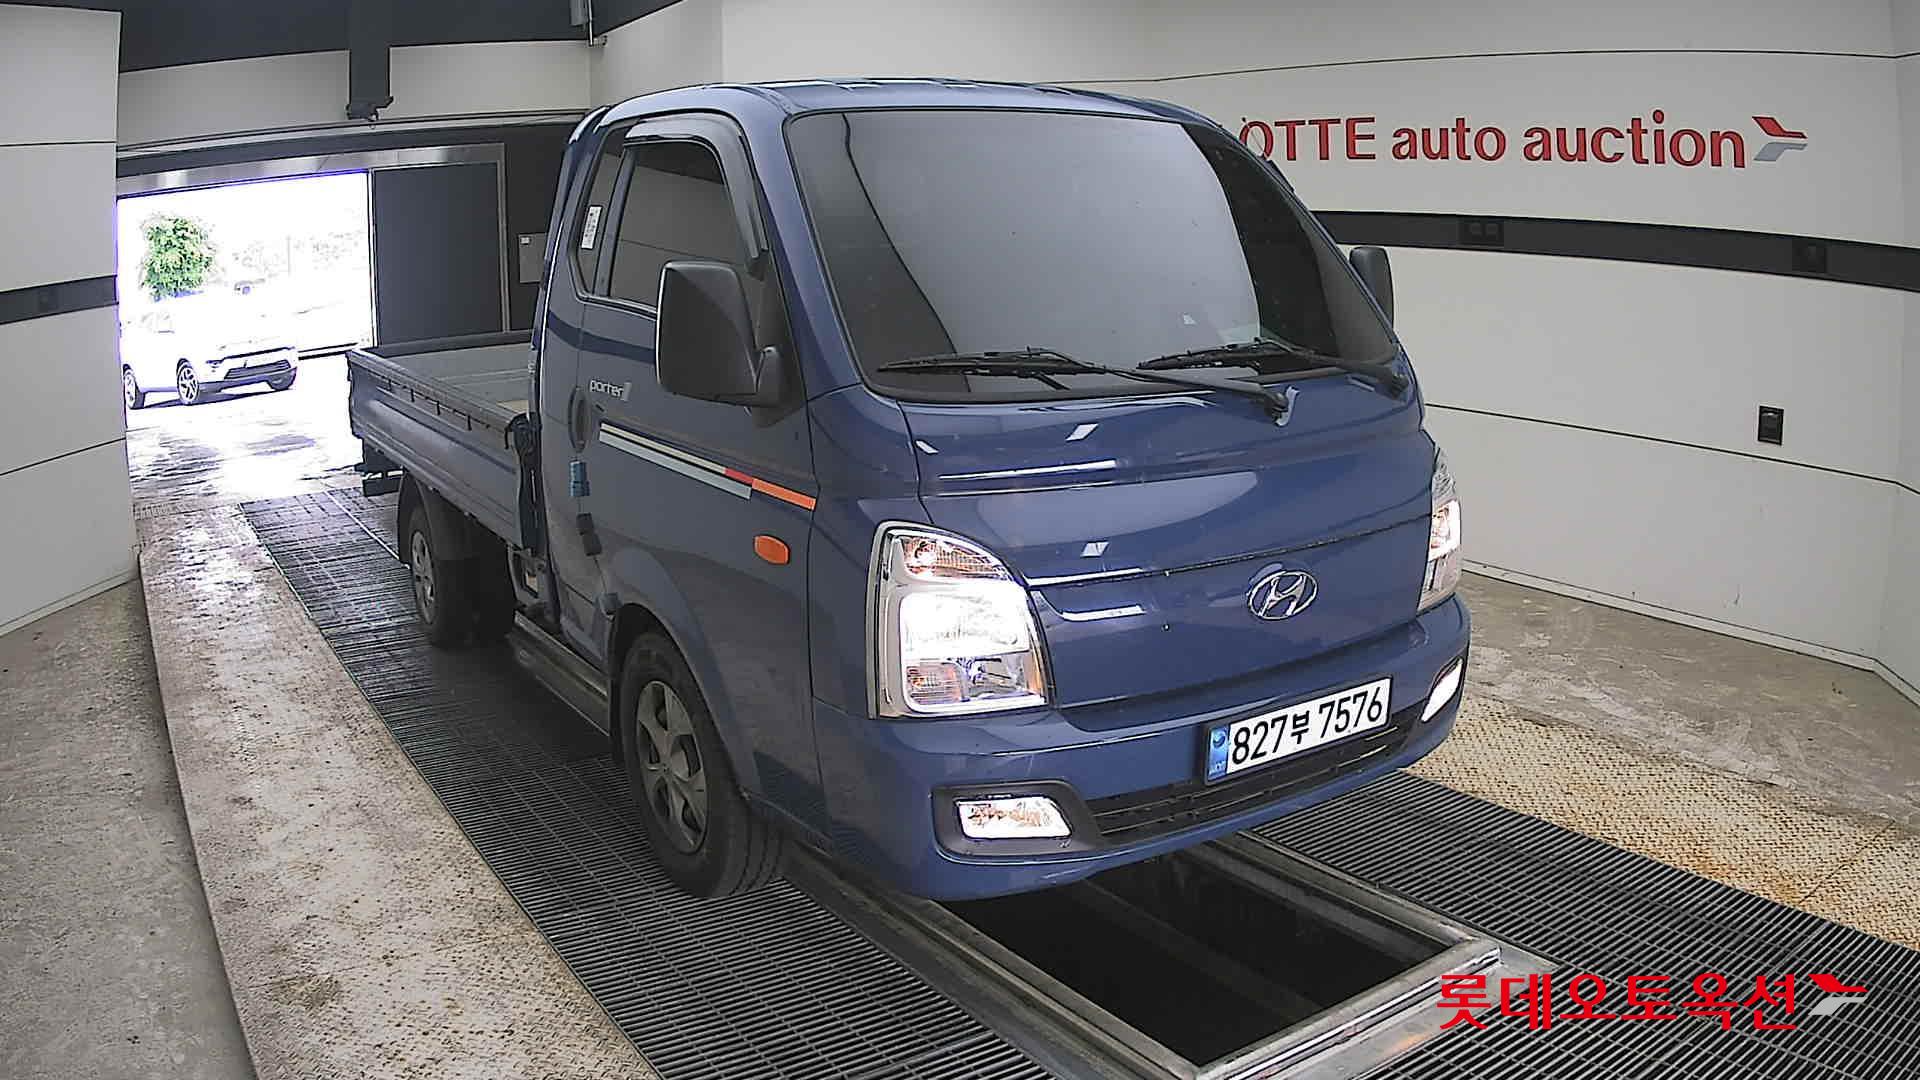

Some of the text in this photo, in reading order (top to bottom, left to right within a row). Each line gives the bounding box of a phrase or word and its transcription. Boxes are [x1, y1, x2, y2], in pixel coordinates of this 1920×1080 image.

[1238, 109, 1746, 168] OTTE auto auction
[590, 380, 625, 399] porter
[1232, 686, 1383, 765] 827부 7576
